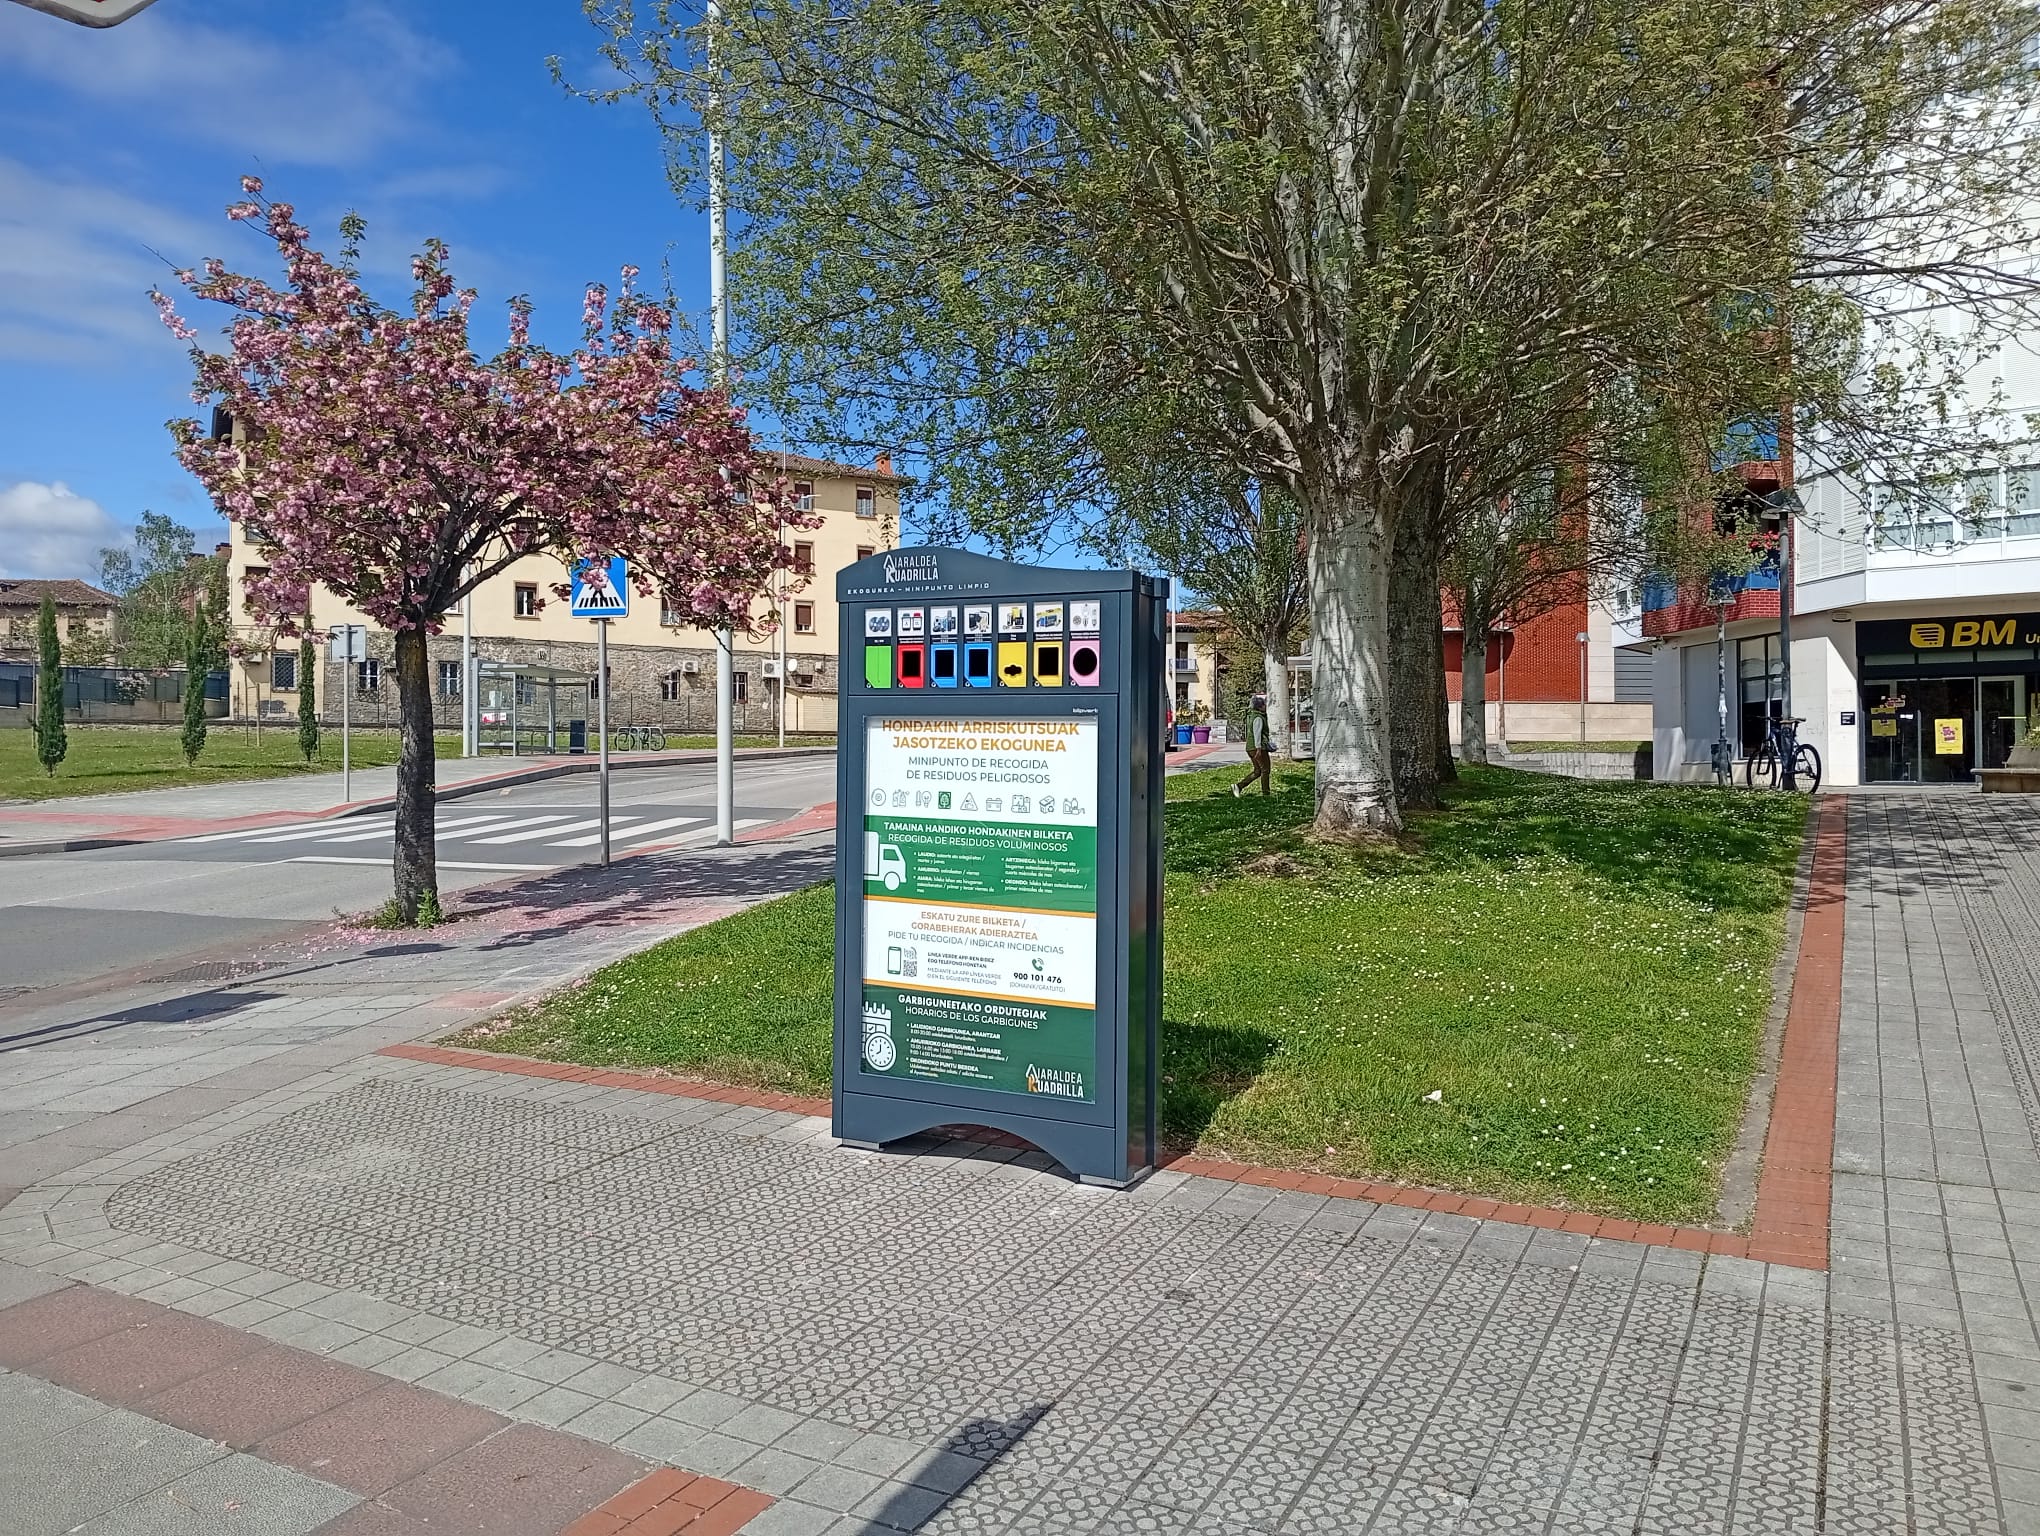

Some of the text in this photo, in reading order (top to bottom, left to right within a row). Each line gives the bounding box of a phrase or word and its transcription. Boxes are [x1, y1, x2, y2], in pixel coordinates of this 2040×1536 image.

[885, 564, 939, 583] KUADRILLA
[847, 587, 895, 595] EKOGUNEA
[905, 584, 954, 592] MINIPUNTO
[958, 582, 990, 590] LIMPIO
[1951, 619, 2017, 647] BM
[882, 719, 1080, 736] HONDAKIN ARRISKUTSUAK
[893, 735, 1067, 752] JASOTZEKO EKOGUNEA
[908, 756, 1049, 770] MINIPUNTO DE RECOGIDA
[906, 769, 1051, 784] DE RESIDUOS PELIGROSOS
[883, 821, 1074, 841] TAMAINA HANDIKO HONDAKINEN BILKETA
[888, 833, 1068, 852] RECOGIDA DE RESIDUOS VOLUMINOSOS
[920, 911, 956, 922] ESKATU
[956, 914, 981, 924] ZURE
[982, 916, 1021, 928] BILKETA
[911, 921, 1038, 941] GORABEHERAK ADIERAZTEA
[888, 930, 907, 940] PIDE
[908, 931, 919, 941] TU
[920, 933, 963, 946] RECOGIDA
[969, 938, 1005, 949] INDICAR
[1007, 942, 1064, 955] INCIDENCIAS
[1013, 972, 1062, 984] 900 101 476
[898, 993, 1048, 1021] GARBIGUNEETAKO ORDUTEGIAK
[905, 1005, 1039, 1031] HORARIOS DE LOS GARBIGUNES
[1025, 1063, 1083, 1085] AIARALDEA
[1027, 1073, 1084, 1099] KUADRILLA
